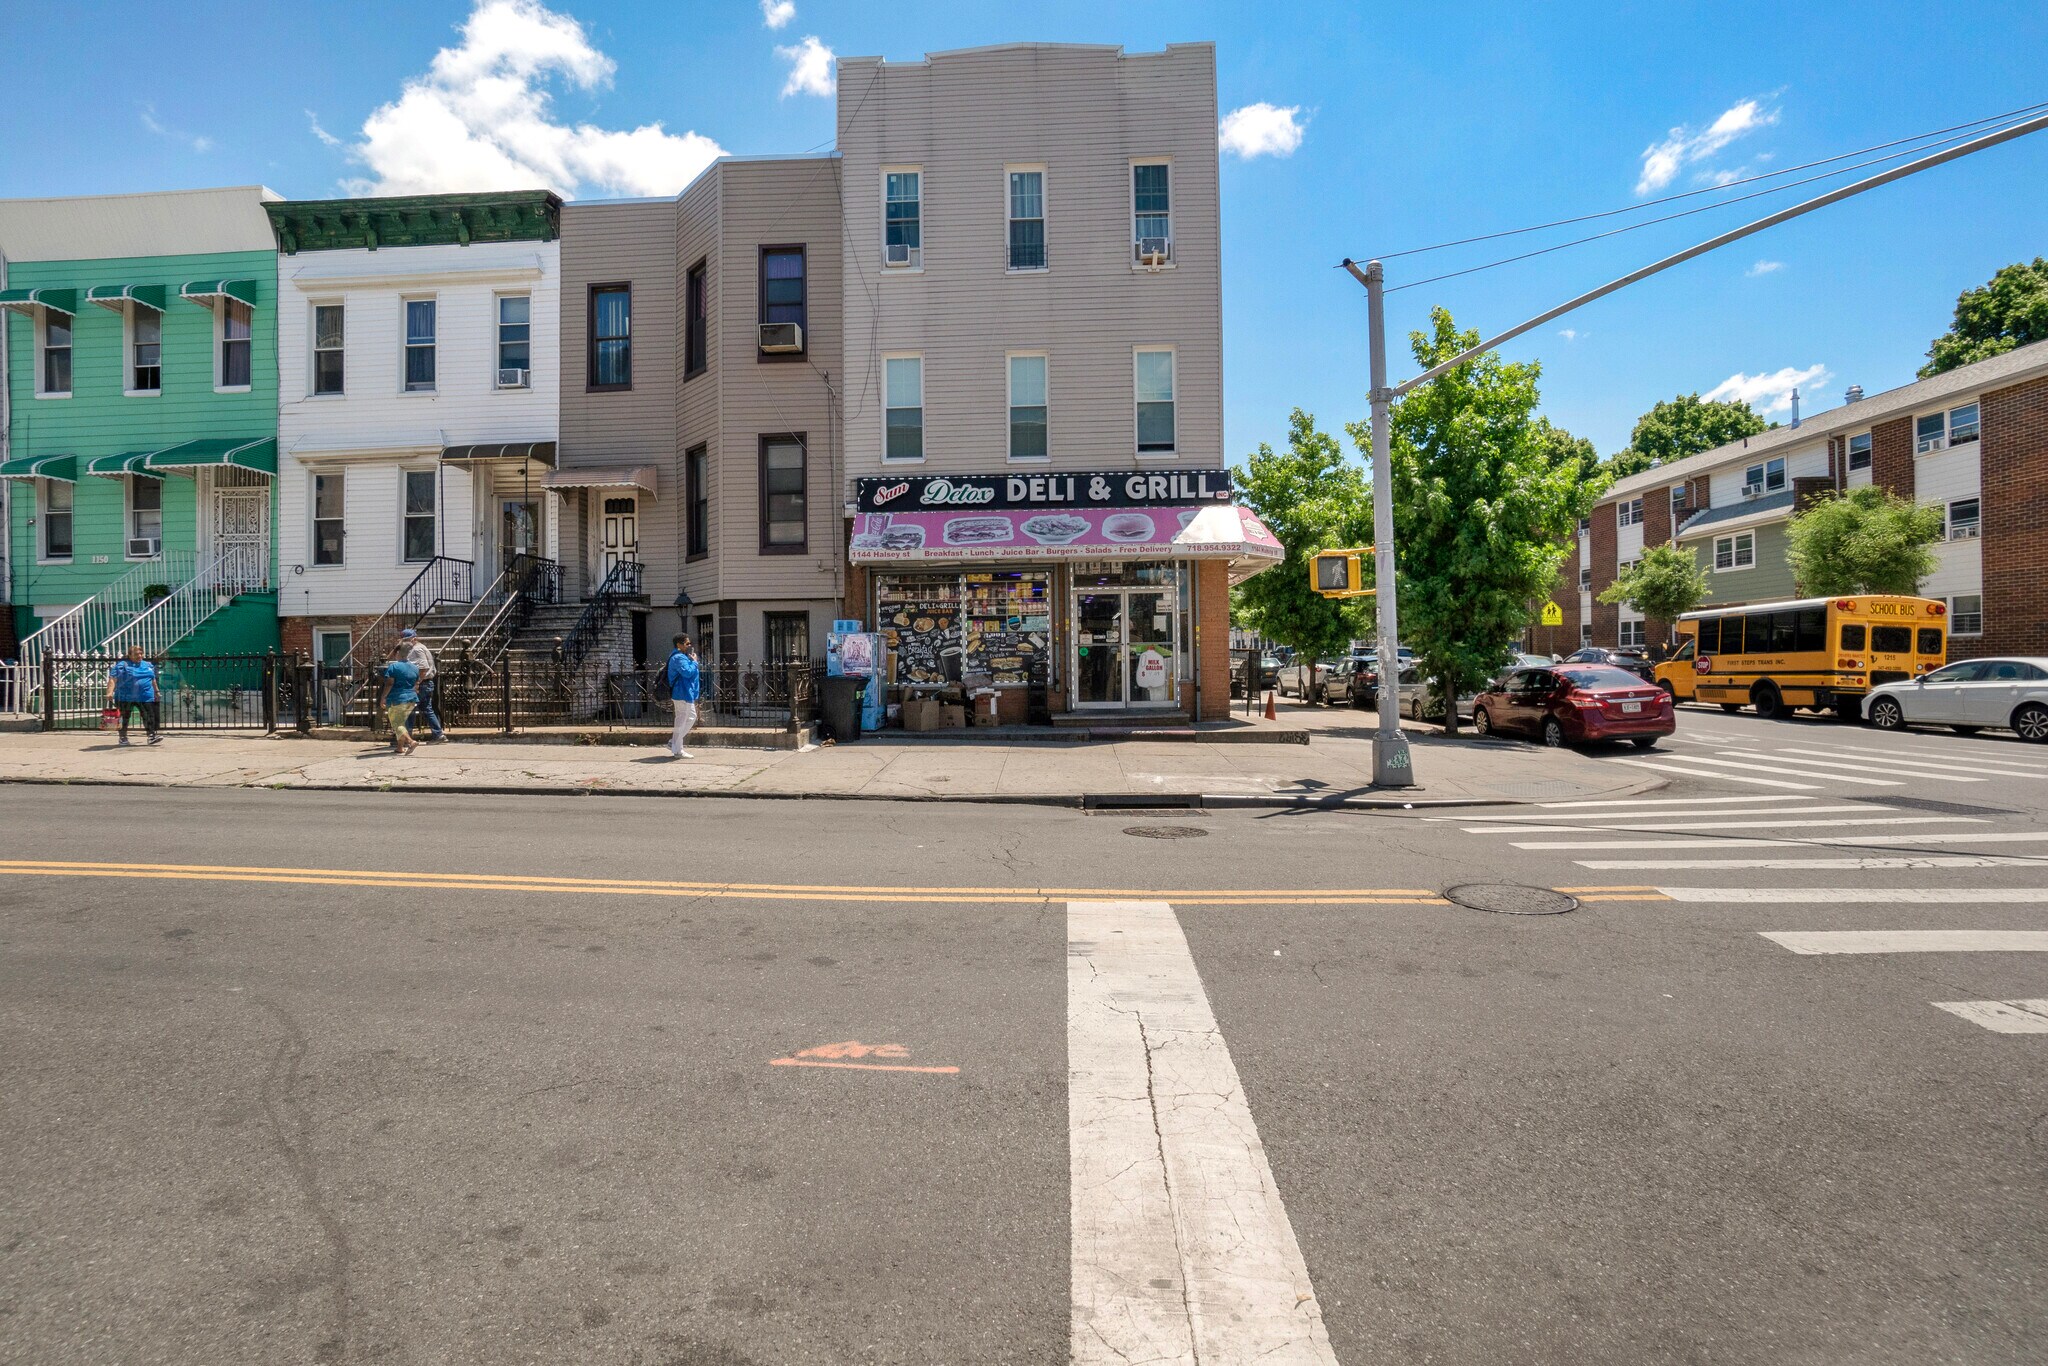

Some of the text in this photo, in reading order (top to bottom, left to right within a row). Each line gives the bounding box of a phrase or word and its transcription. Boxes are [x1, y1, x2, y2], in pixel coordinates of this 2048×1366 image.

[874, 482, 910, 506] Sam
[920, 479, 995, 505] Detox
[1006, 474, 1215, 502] DELI & GRILL
[1001, 548, 1024, 556] Juice
[1046, 547, 1078, 556] Burgers
[1085, 546, 1112, 554] Salads
[1139, 545, 1173, 554] Delivery
[1186, 544, 1242, 552] 718.954.9322
[873, 551, 901, 560] Halsey
[902, 550, 911, 558] st
[1870, 603, 1915, 616] SCHOOL BUS
[1697, 661, 1709, 669] STOP
